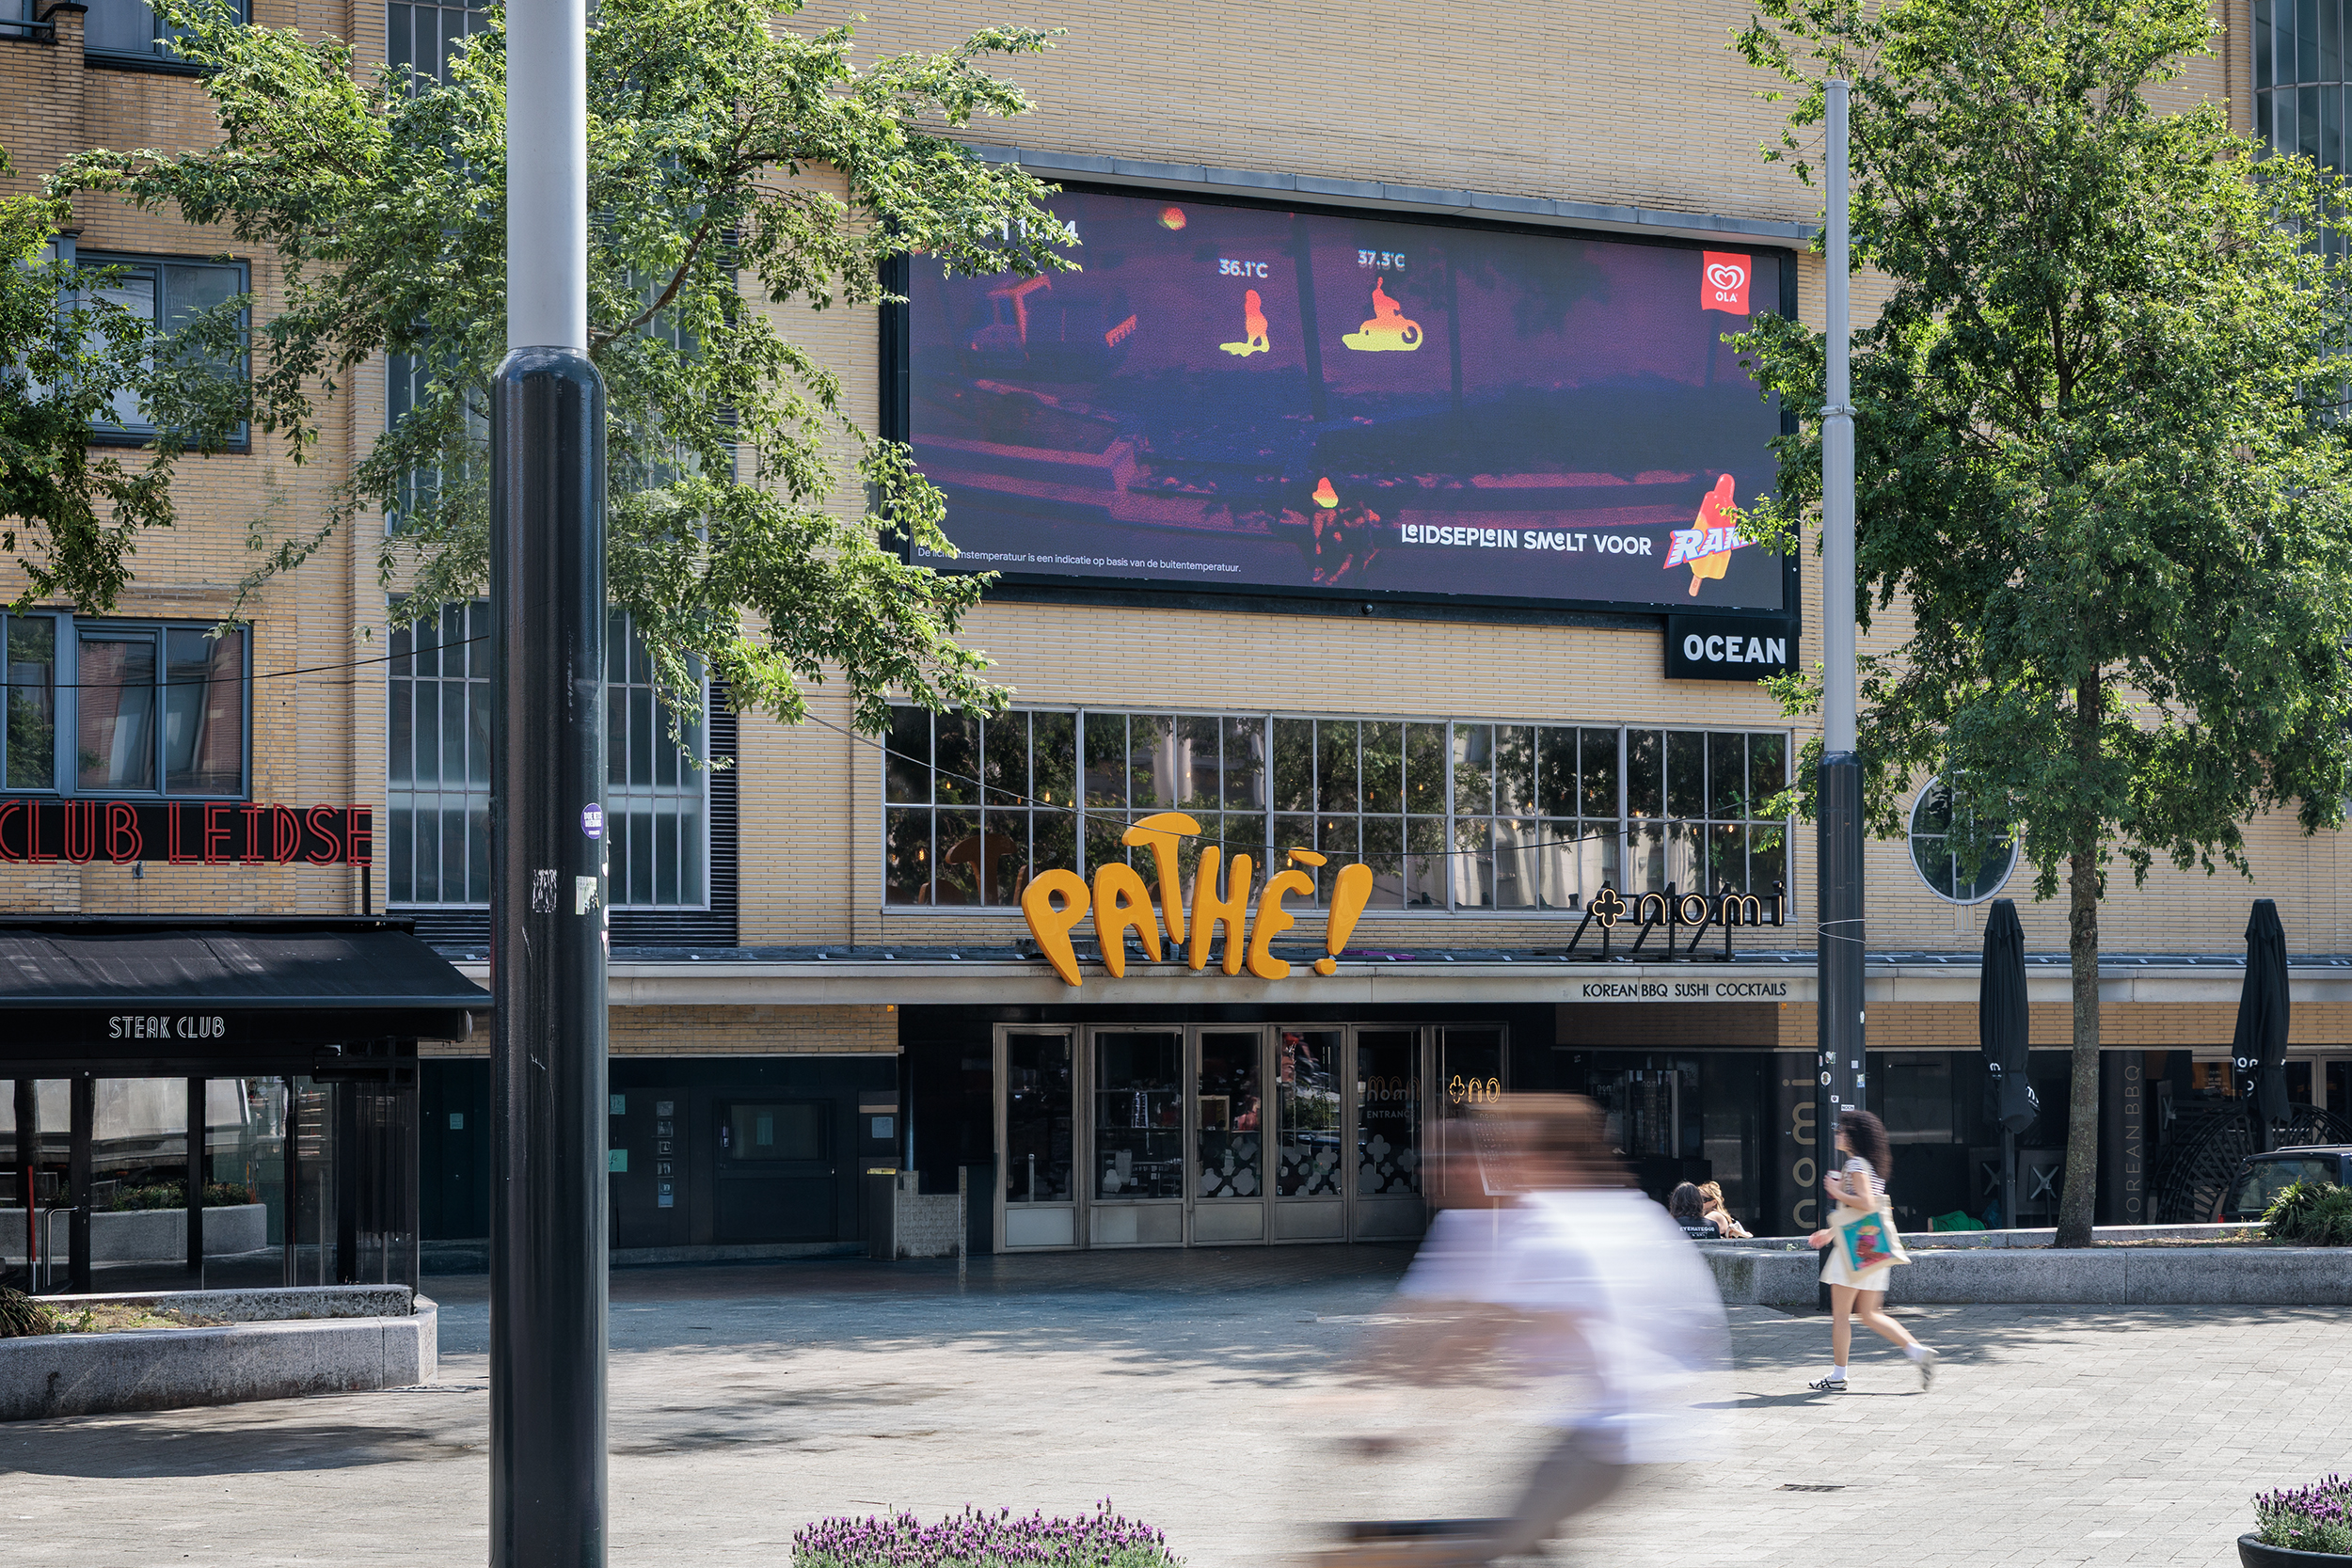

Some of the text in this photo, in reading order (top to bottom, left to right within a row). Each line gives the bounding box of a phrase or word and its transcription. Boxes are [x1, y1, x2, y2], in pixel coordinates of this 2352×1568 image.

[1715, 291, 1738, 303] OLA
[917, 546, 930, 558] De
[1028, 552, 1035, 562] is
[1037, 555, 1054, 563] een
[1055, 553, 1091, 565] indicatie
[1093, 558, 1105, 567] op
[1106, 556, 1129, 566] basis
[1130, 559, 1146, 568] van
[1147, 558, 1158, 568] de
[1160, 559, 1242, 573] buitentemperatuur.
[1593, 533, 1652, 556] VOOR
[1663, 527, 1761, 569] RAK
[1683, 633, 1787, 664] OCEAN
[0, 800, 373, 867] CLUB LEIDSE
[1022, 812, 1374, 987] PATHÉ!
[1632, 880, 1785, 927] nomi
[1582, 983, 1787, 998] KOREAN BBQ SUSHI COCKTAILS
[109, 1016, 225, 1038] STEAK CLUB
[2124, 1065, 2141, 1115] BBQ
[1367, 1110, 1416, 1119] ENTRANCE
[1782, 1078, 1818, 1229] nomi
